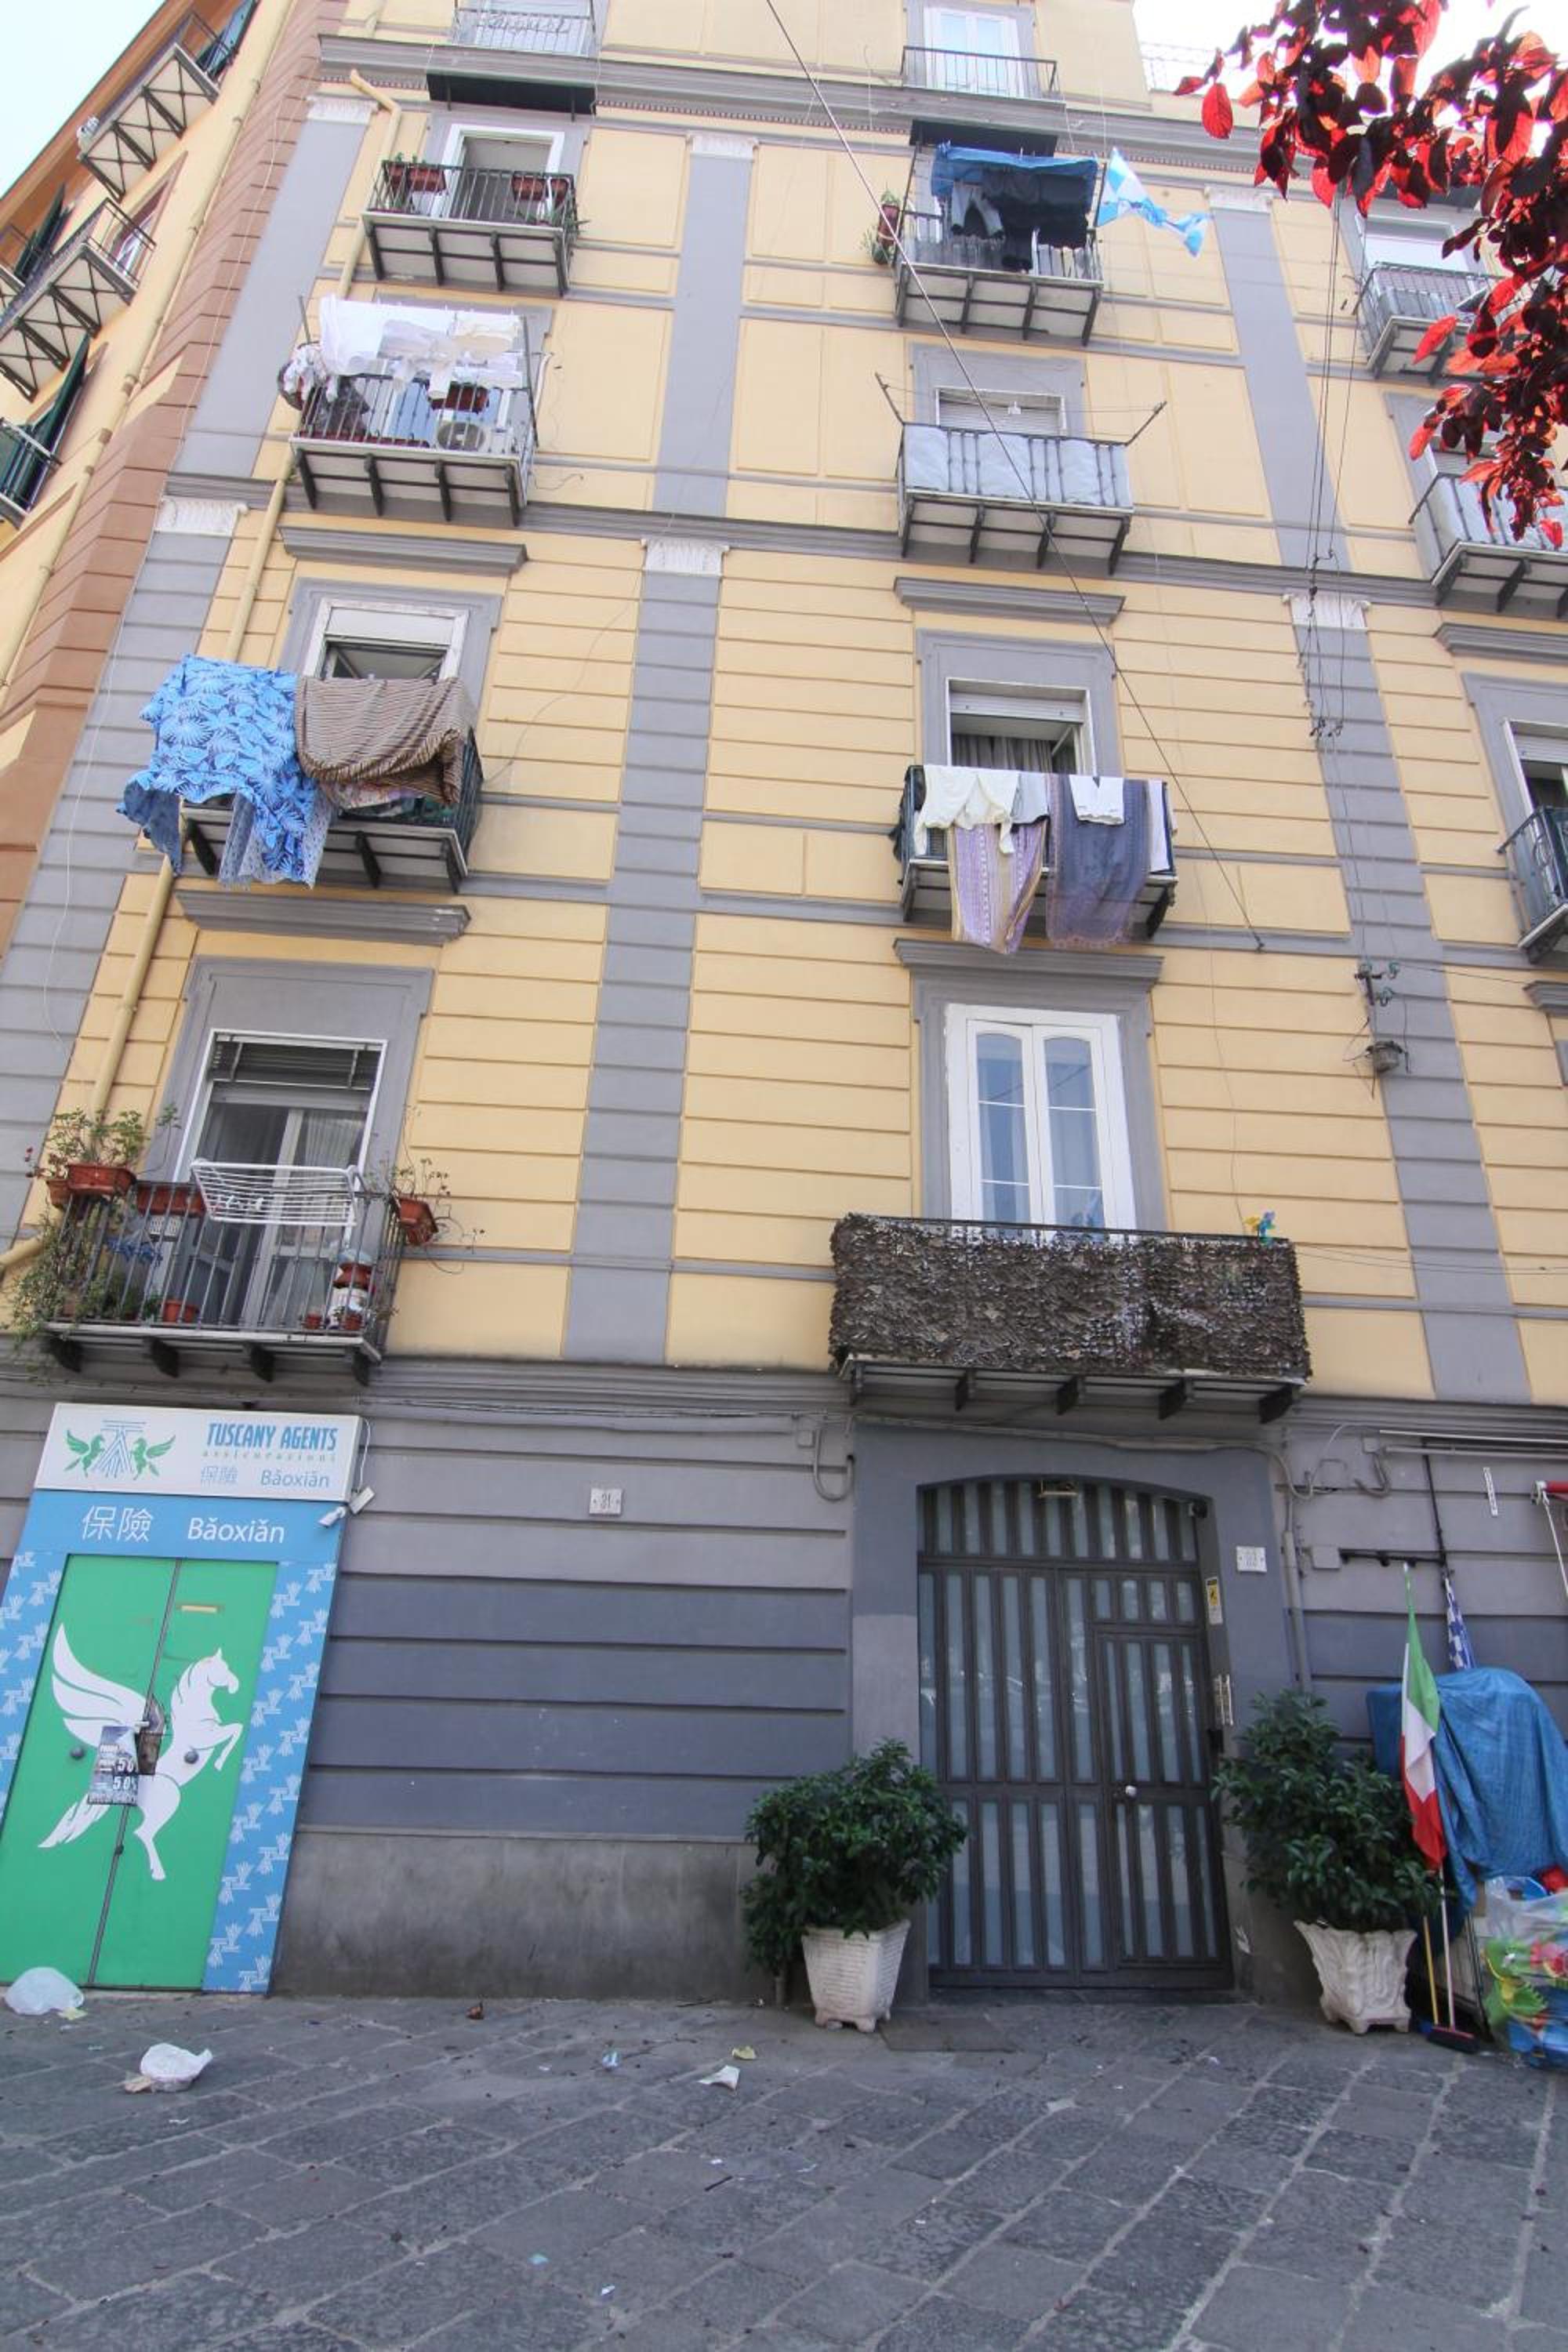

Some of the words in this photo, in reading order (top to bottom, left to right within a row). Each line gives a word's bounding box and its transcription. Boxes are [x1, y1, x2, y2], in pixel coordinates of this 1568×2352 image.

[207, 1423, 276, 1448] TUSCANY
[280, 1426, 338, 1450] AGENTS
[82, 1505, 154, 1542] 保險
[187, 1517, 285, 1544] Bǎoxiǎn
